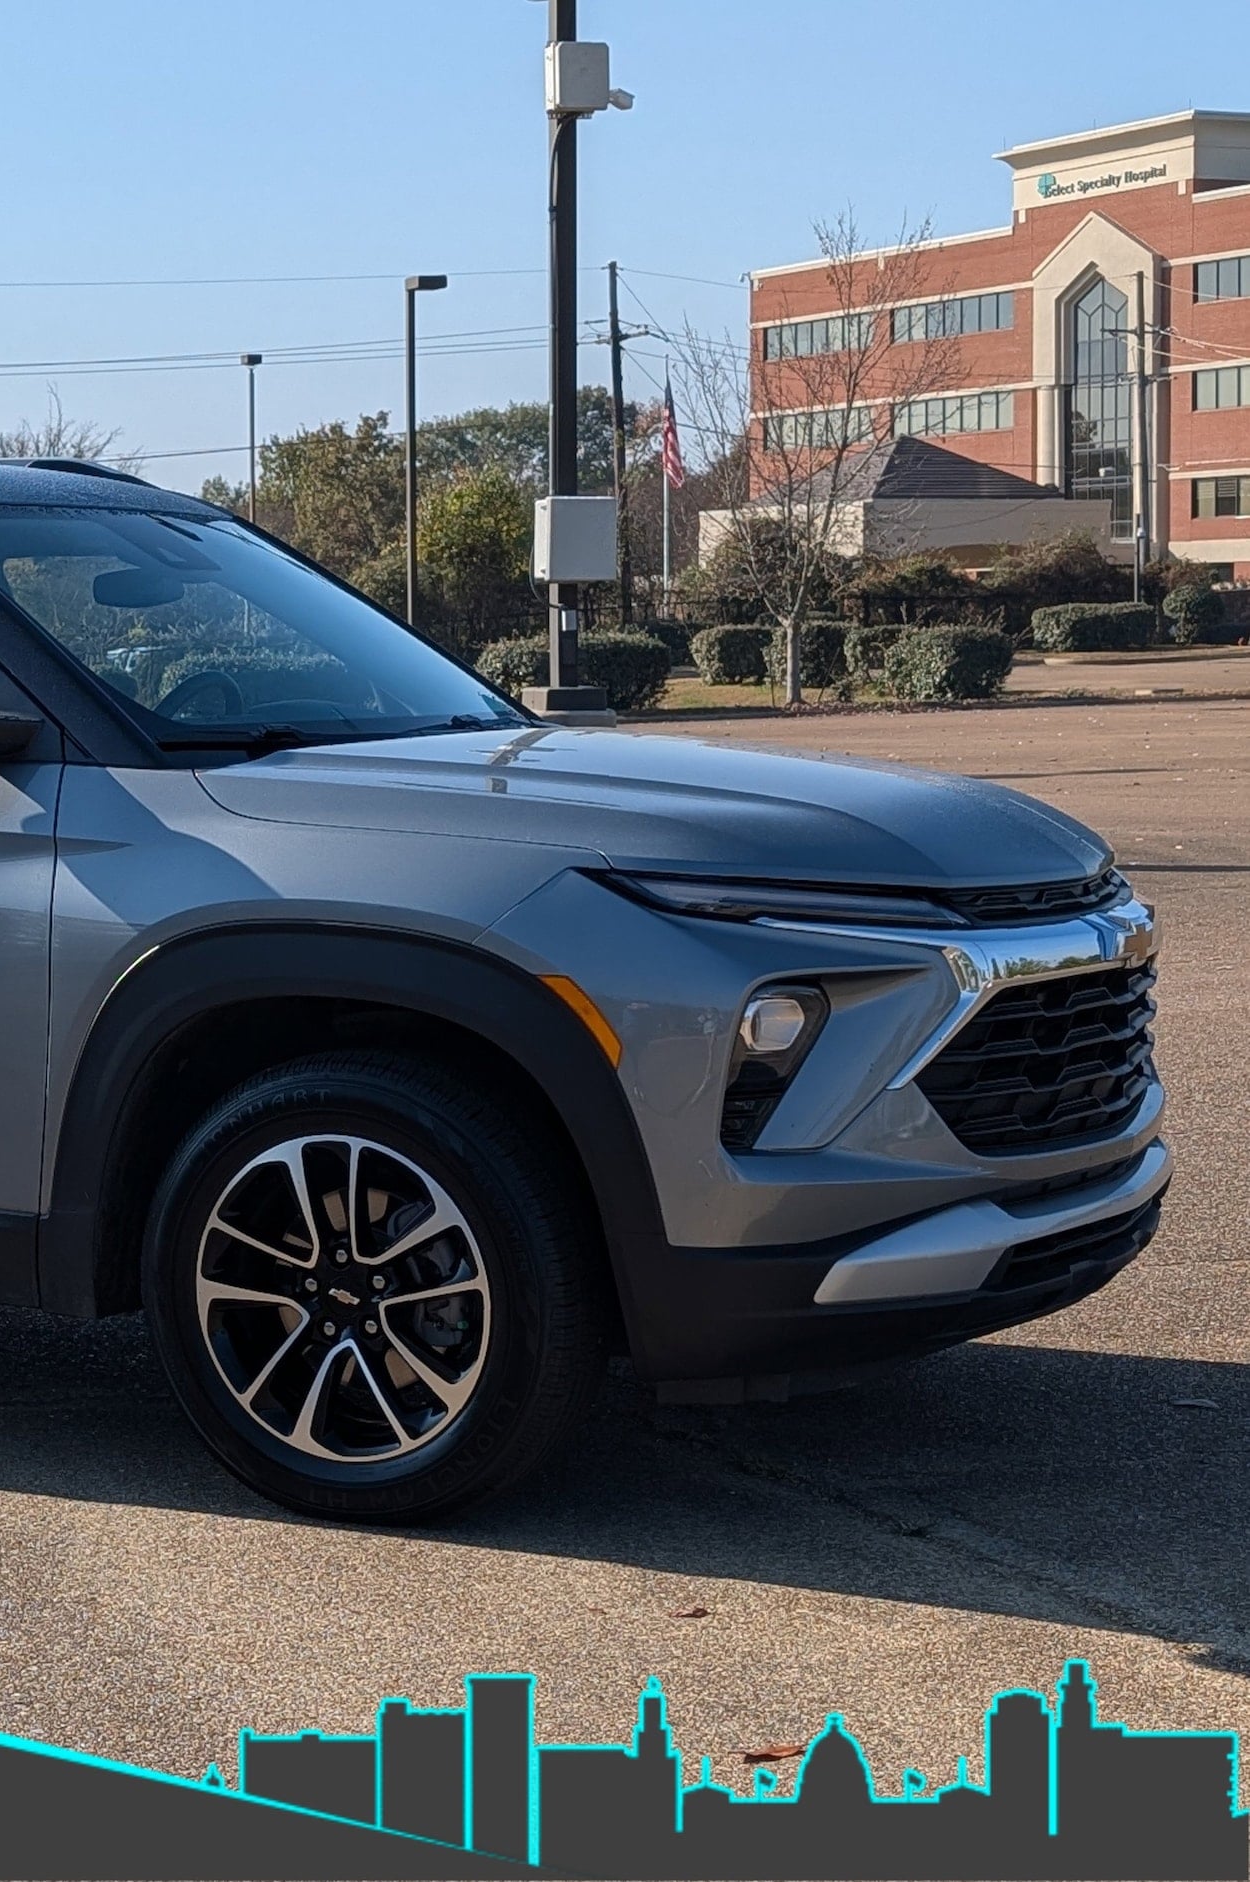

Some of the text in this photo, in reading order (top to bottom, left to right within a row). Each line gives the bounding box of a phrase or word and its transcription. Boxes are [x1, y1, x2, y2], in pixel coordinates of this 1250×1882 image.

[1044, 164, 1167, 198] Select Specialty Hospital
